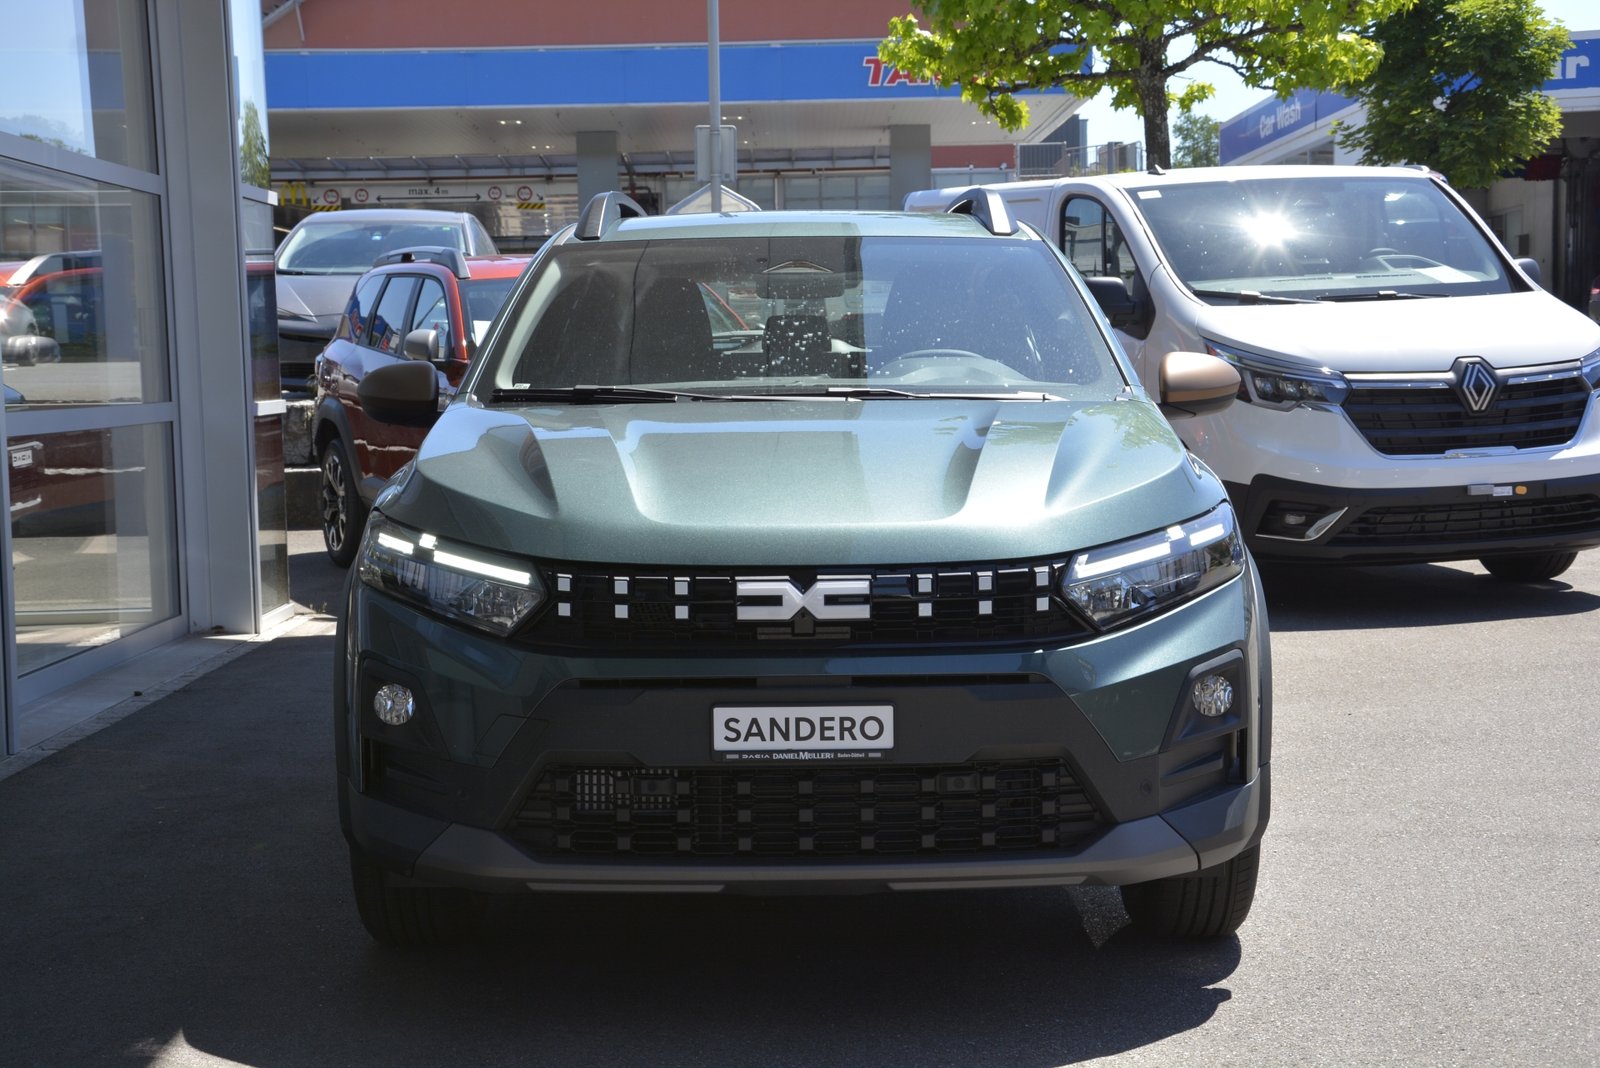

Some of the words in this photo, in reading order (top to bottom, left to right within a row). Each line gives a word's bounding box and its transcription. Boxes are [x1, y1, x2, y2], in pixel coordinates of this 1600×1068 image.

[1260, 114, 1275, 139] Car
[1276, 97, 1301, 130] Wash
[408, 187, 431, 196] max.
[723, 715, 885, 743] SANDERO
